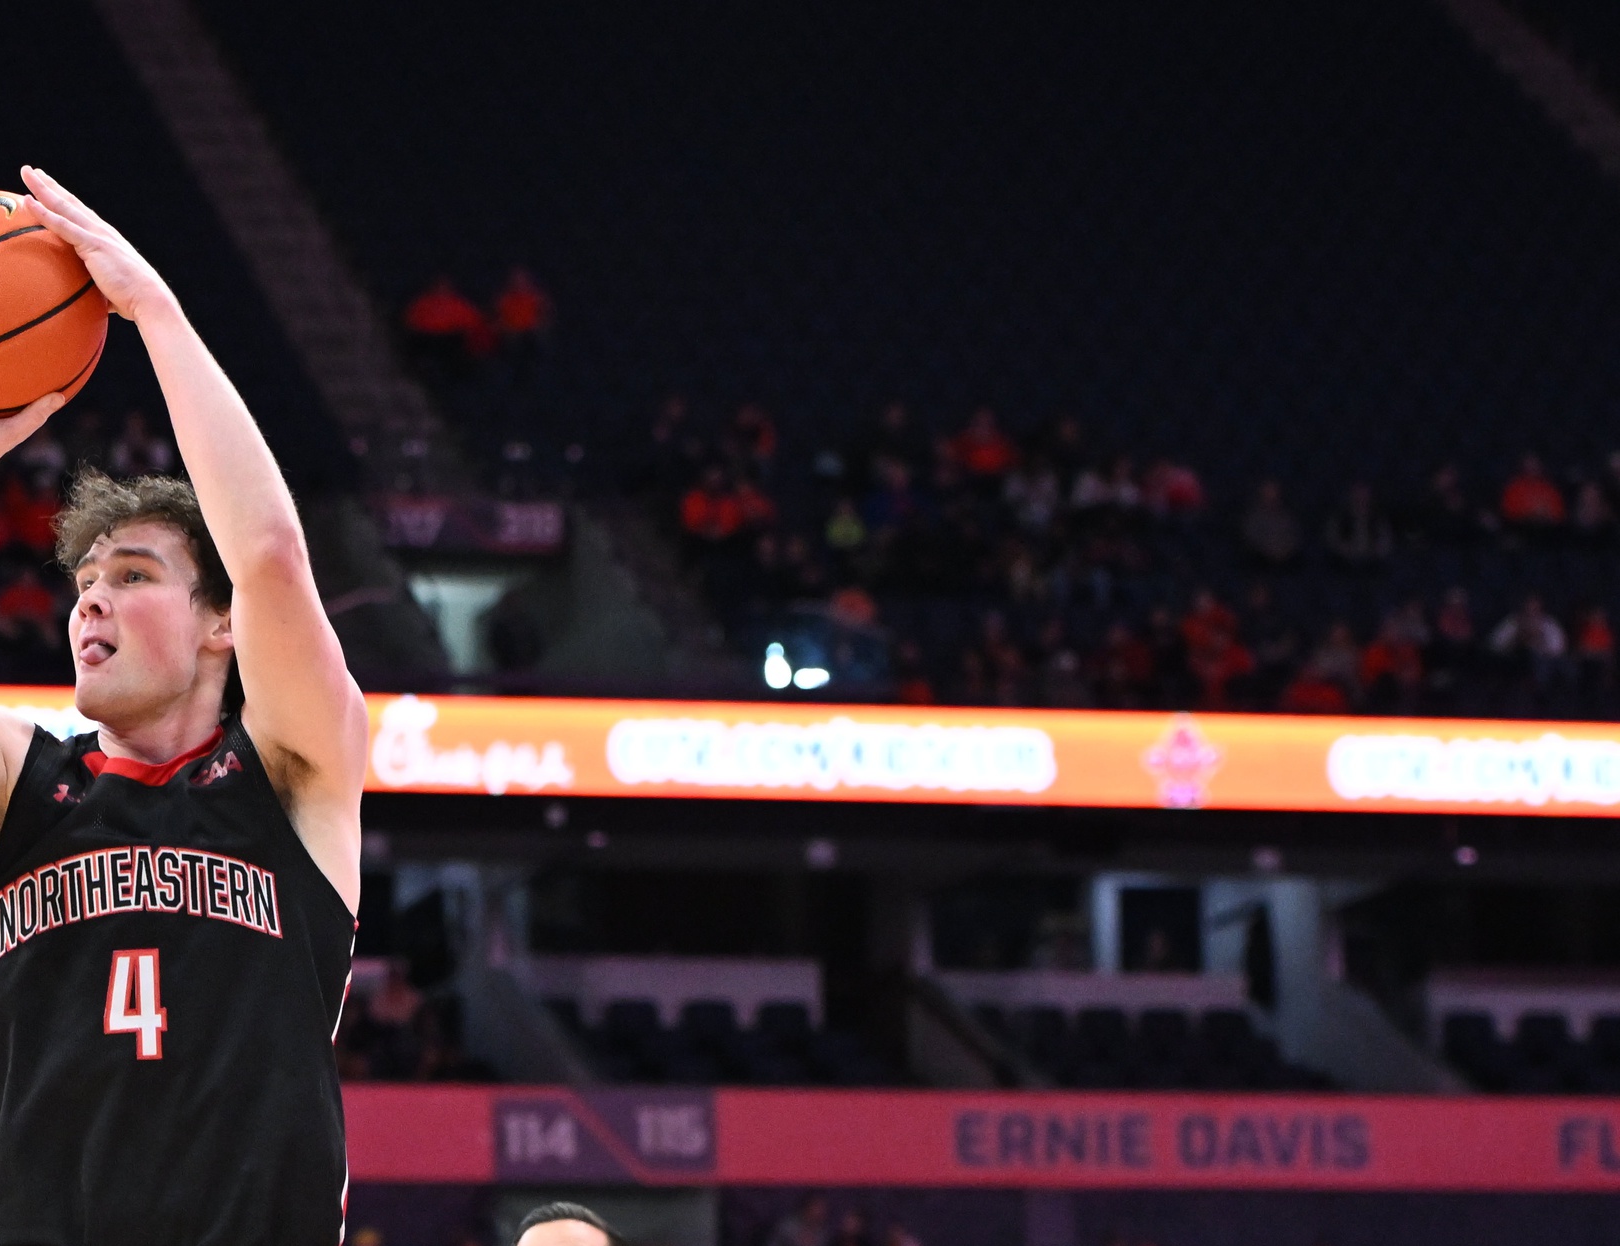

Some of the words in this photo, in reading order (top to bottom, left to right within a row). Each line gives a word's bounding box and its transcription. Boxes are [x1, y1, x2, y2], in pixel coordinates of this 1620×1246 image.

[104, 948, 167, 1060] 4
[504, 1112, 577, 1163] 114
[955, 1110, 1152, 1170] ERNIE
[1181, 1112, 1370, 1172] DAVIS
